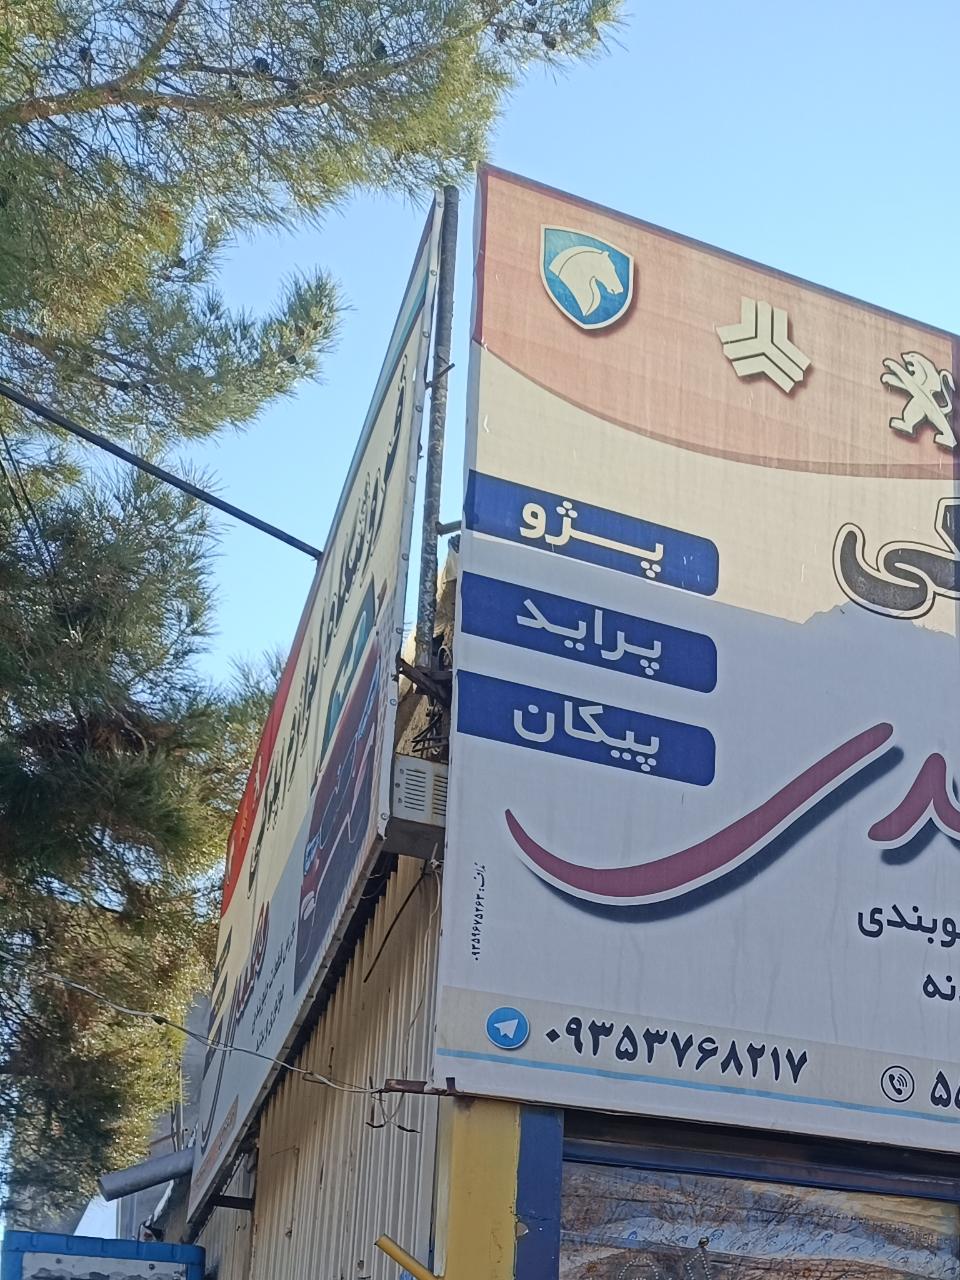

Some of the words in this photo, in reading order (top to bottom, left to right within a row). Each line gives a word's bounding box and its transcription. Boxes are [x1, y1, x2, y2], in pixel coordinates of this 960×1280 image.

[519, 499, 666, 580] پژو
[516, 598, 664, 677] پراید
[513, 699, 662, 773] پیکان
[545, 1016, 808, 1085] ۰۹۳۵۳۷۶۸۲۱۷
